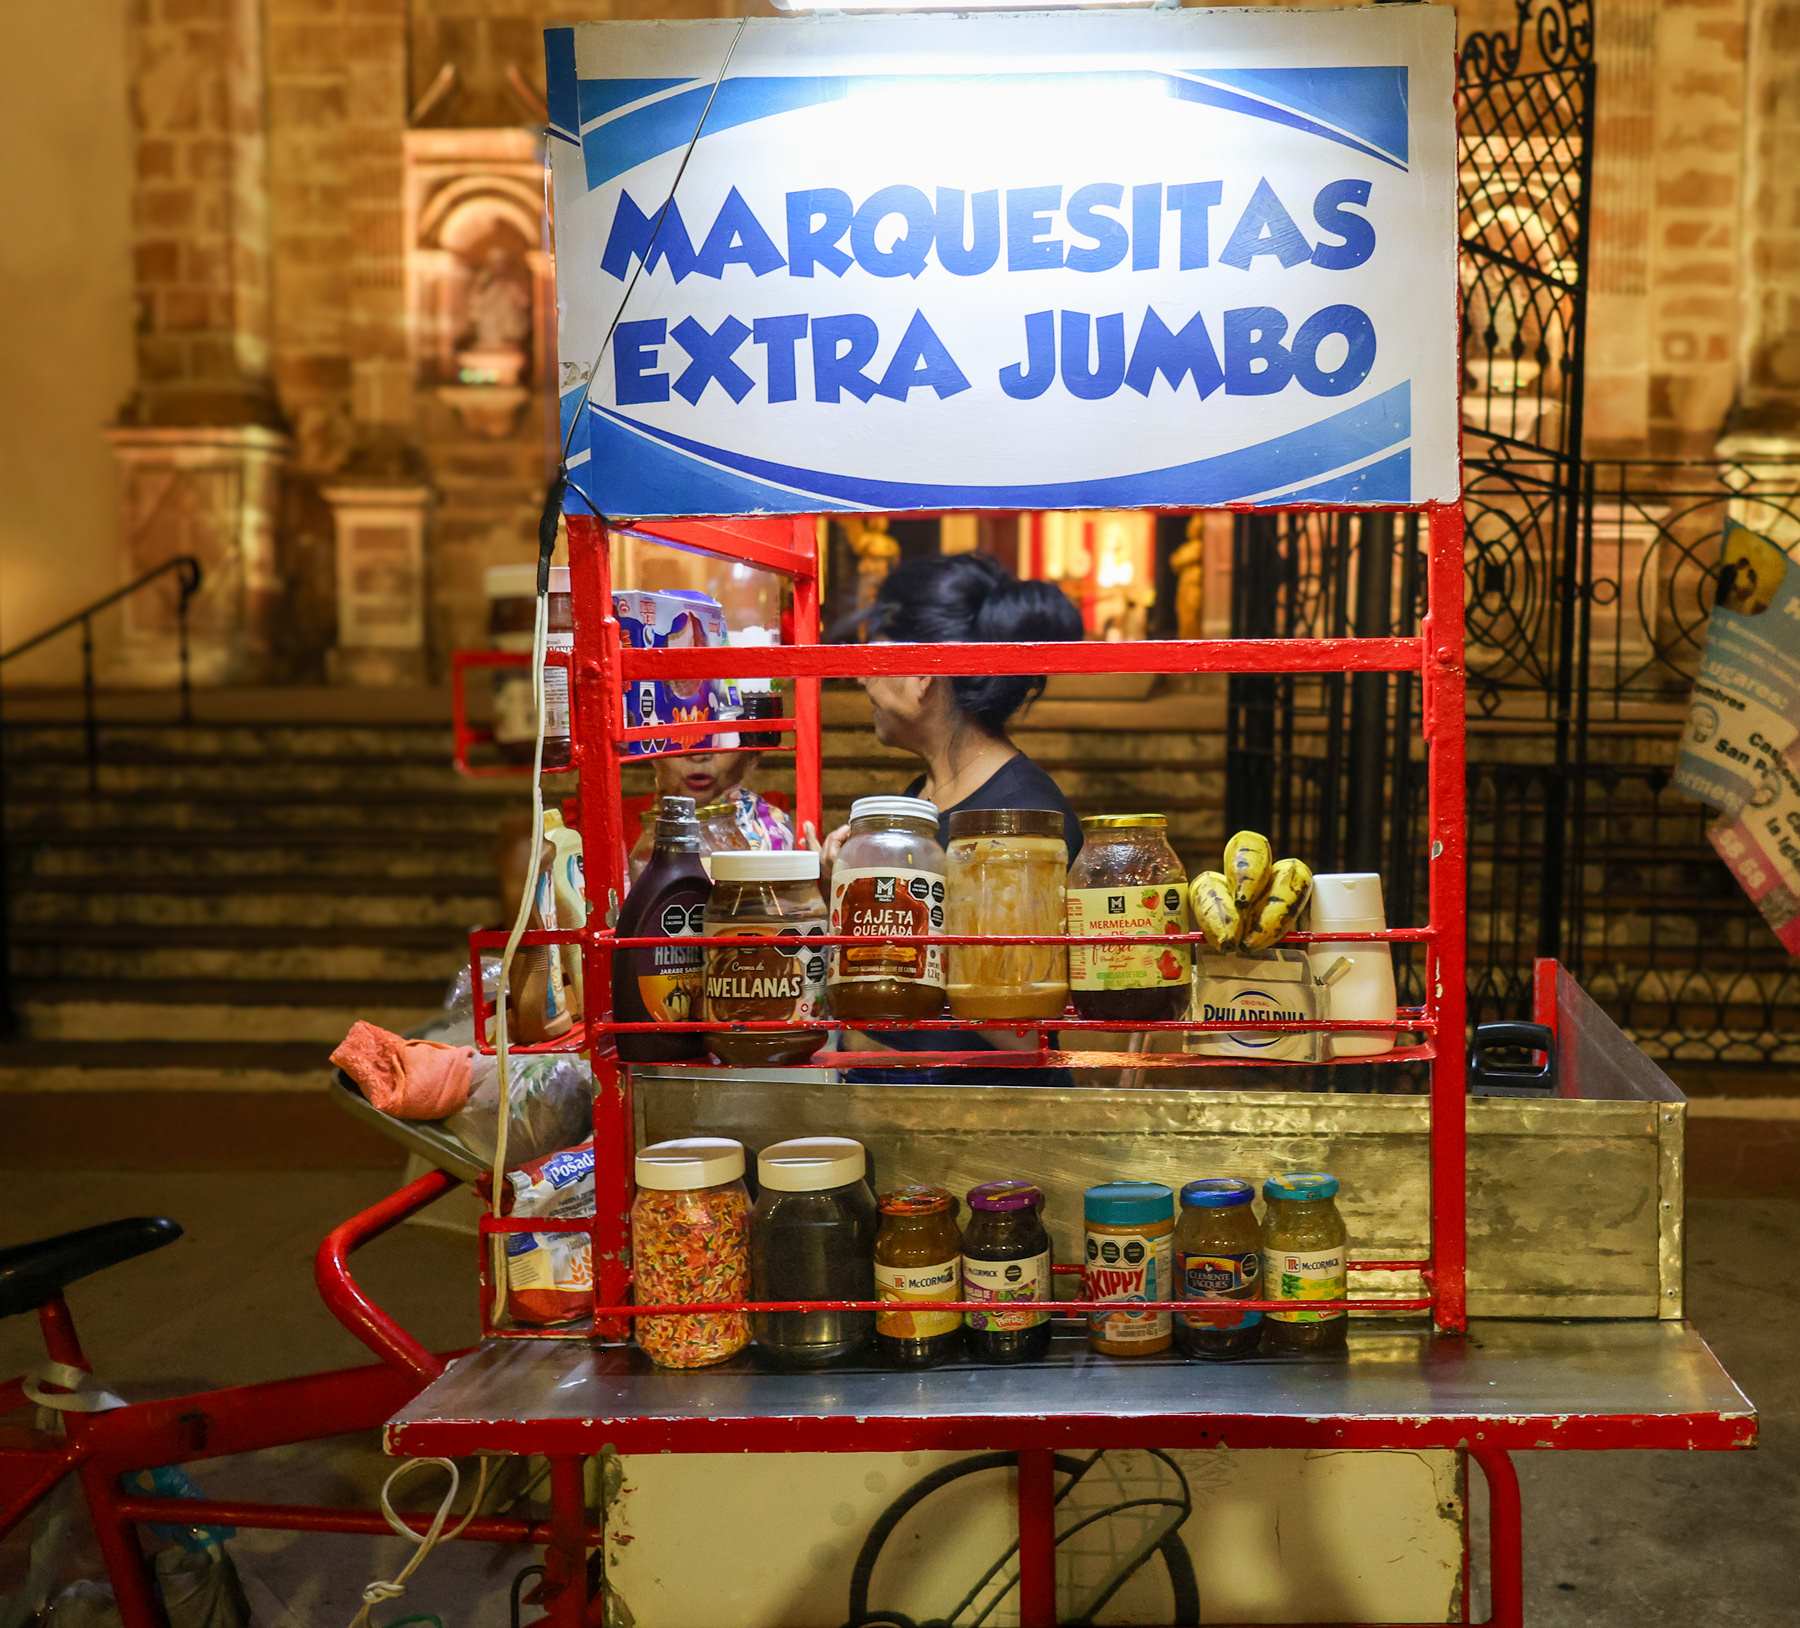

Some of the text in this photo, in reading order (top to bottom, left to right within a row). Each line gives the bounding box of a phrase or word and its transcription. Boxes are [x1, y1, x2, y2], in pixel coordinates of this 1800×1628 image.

[600, 176, 1377, 286] MARQUESITAS
[613, 303, 1377, 406] EXTRA JUMBO
[1714, 737, 1751, 766] San
[853, 908, 914, 925] CAJETA
[1089, 918, 1152, 929] MERMELADA
[853, 925, 914, 937] QUEMADA
[706, 976, 802, 998] AVELLANAS
[550, 1151, 595, 1183] Posad
[1302, 1258, 1338, 1270] McCORMICK
